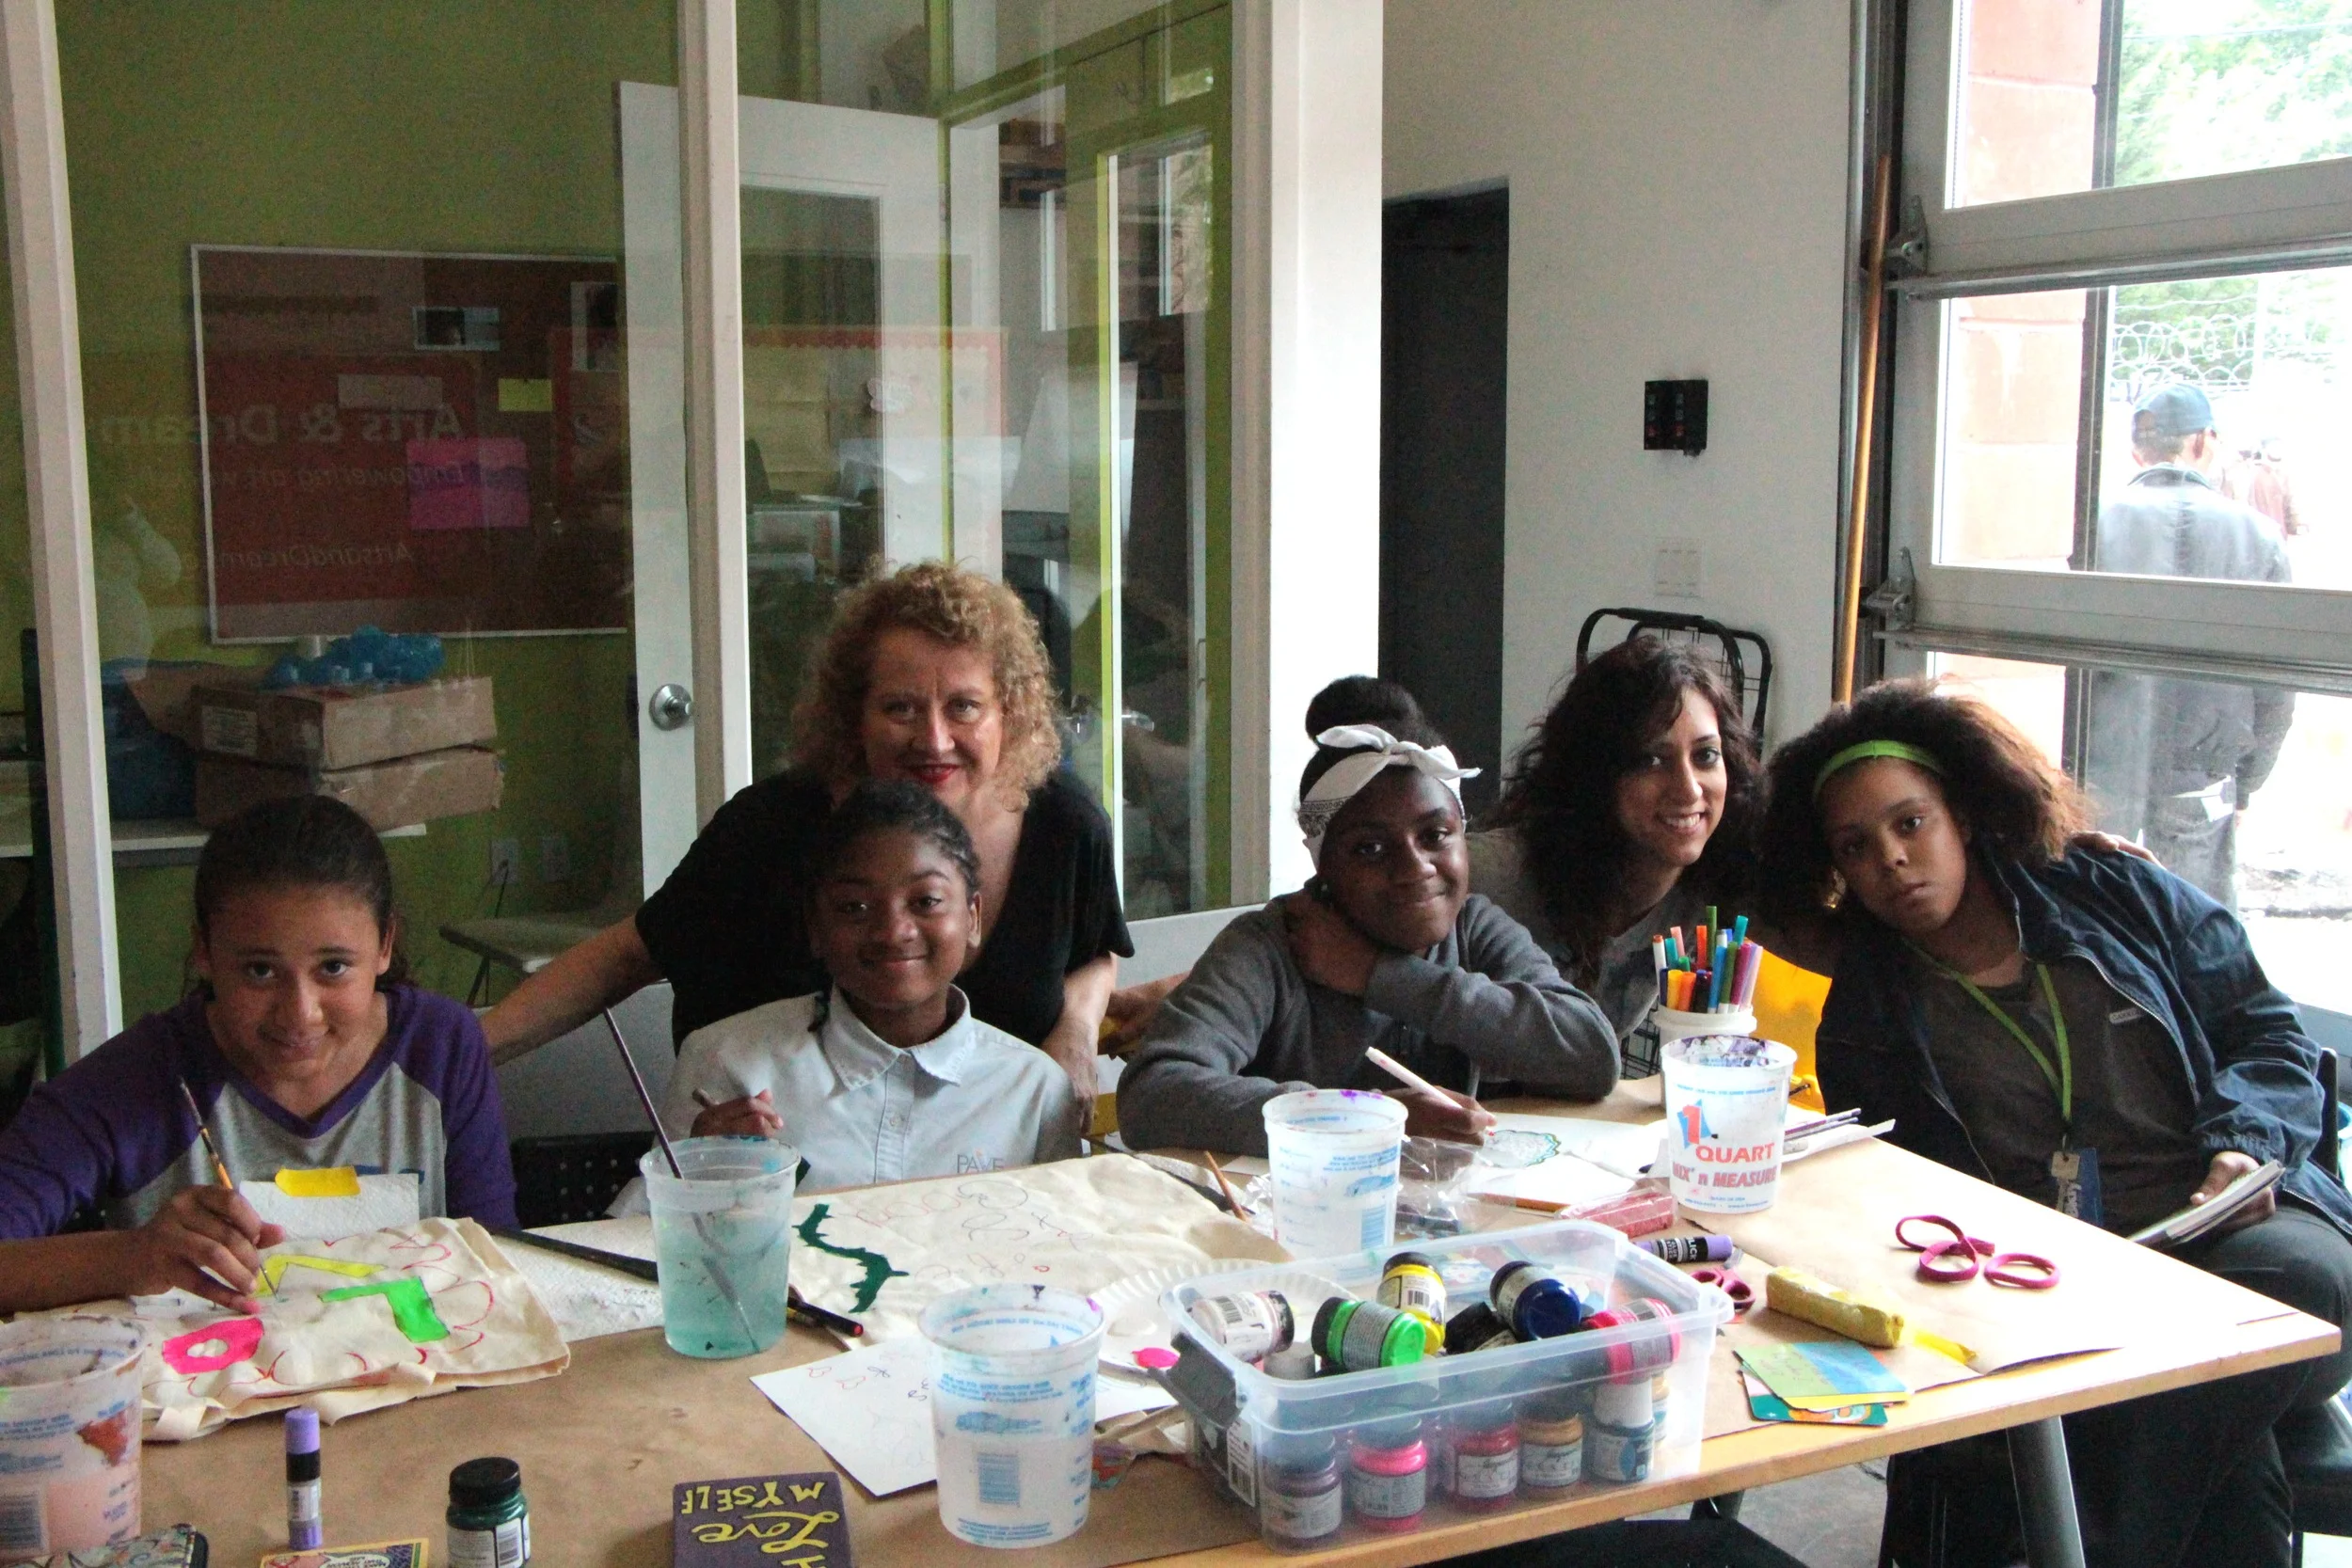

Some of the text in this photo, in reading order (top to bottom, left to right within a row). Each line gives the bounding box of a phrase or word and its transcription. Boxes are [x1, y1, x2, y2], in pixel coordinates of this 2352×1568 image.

[1682, 1104, 1701, 1145] 1
[1695, 1143, 1775, 1164] QUART
[1698, 1173, 1708, 1185] n
[1712, 1165, 1777, 1187] MEASURE
[680, 1481, 825, 1514] MYSELF
[691, 1511, 840, 1553] Love
